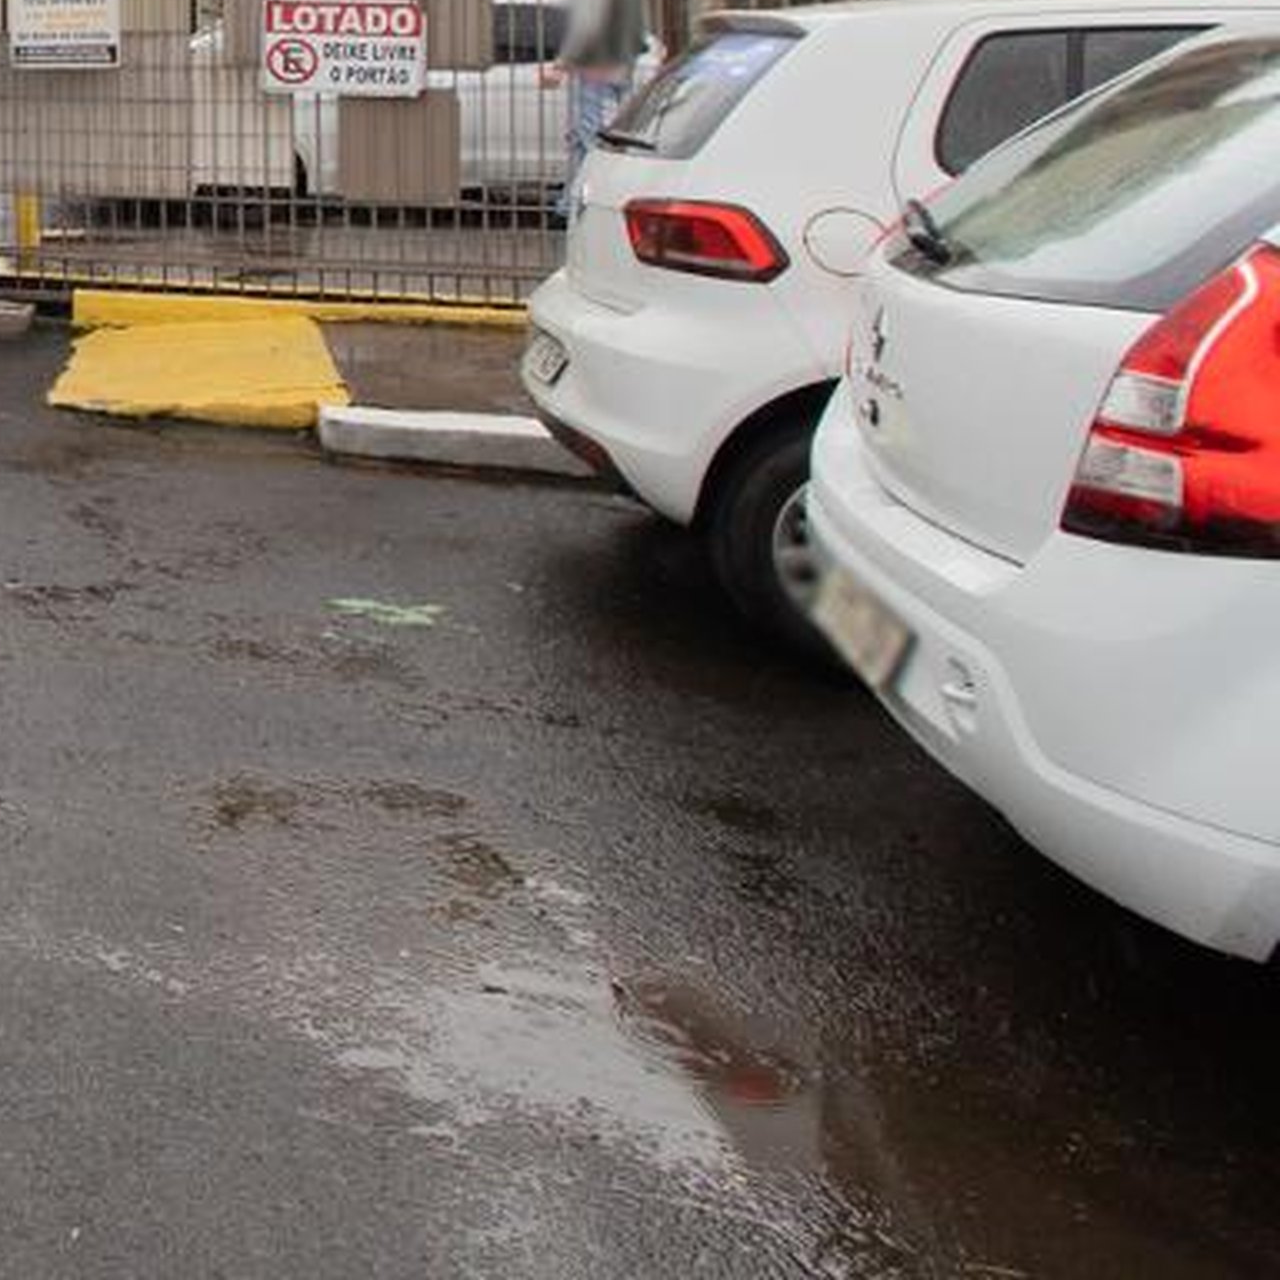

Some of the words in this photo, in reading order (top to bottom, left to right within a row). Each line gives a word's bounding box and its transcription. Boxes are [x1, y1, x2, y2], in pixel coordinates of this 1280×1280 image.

[271, 5, 417, 34] LOTADO
[322, 42, 368, 61] DEIXE
[372, 44, 416, 61] LIVRE
[329, 66, 341, 83] O
